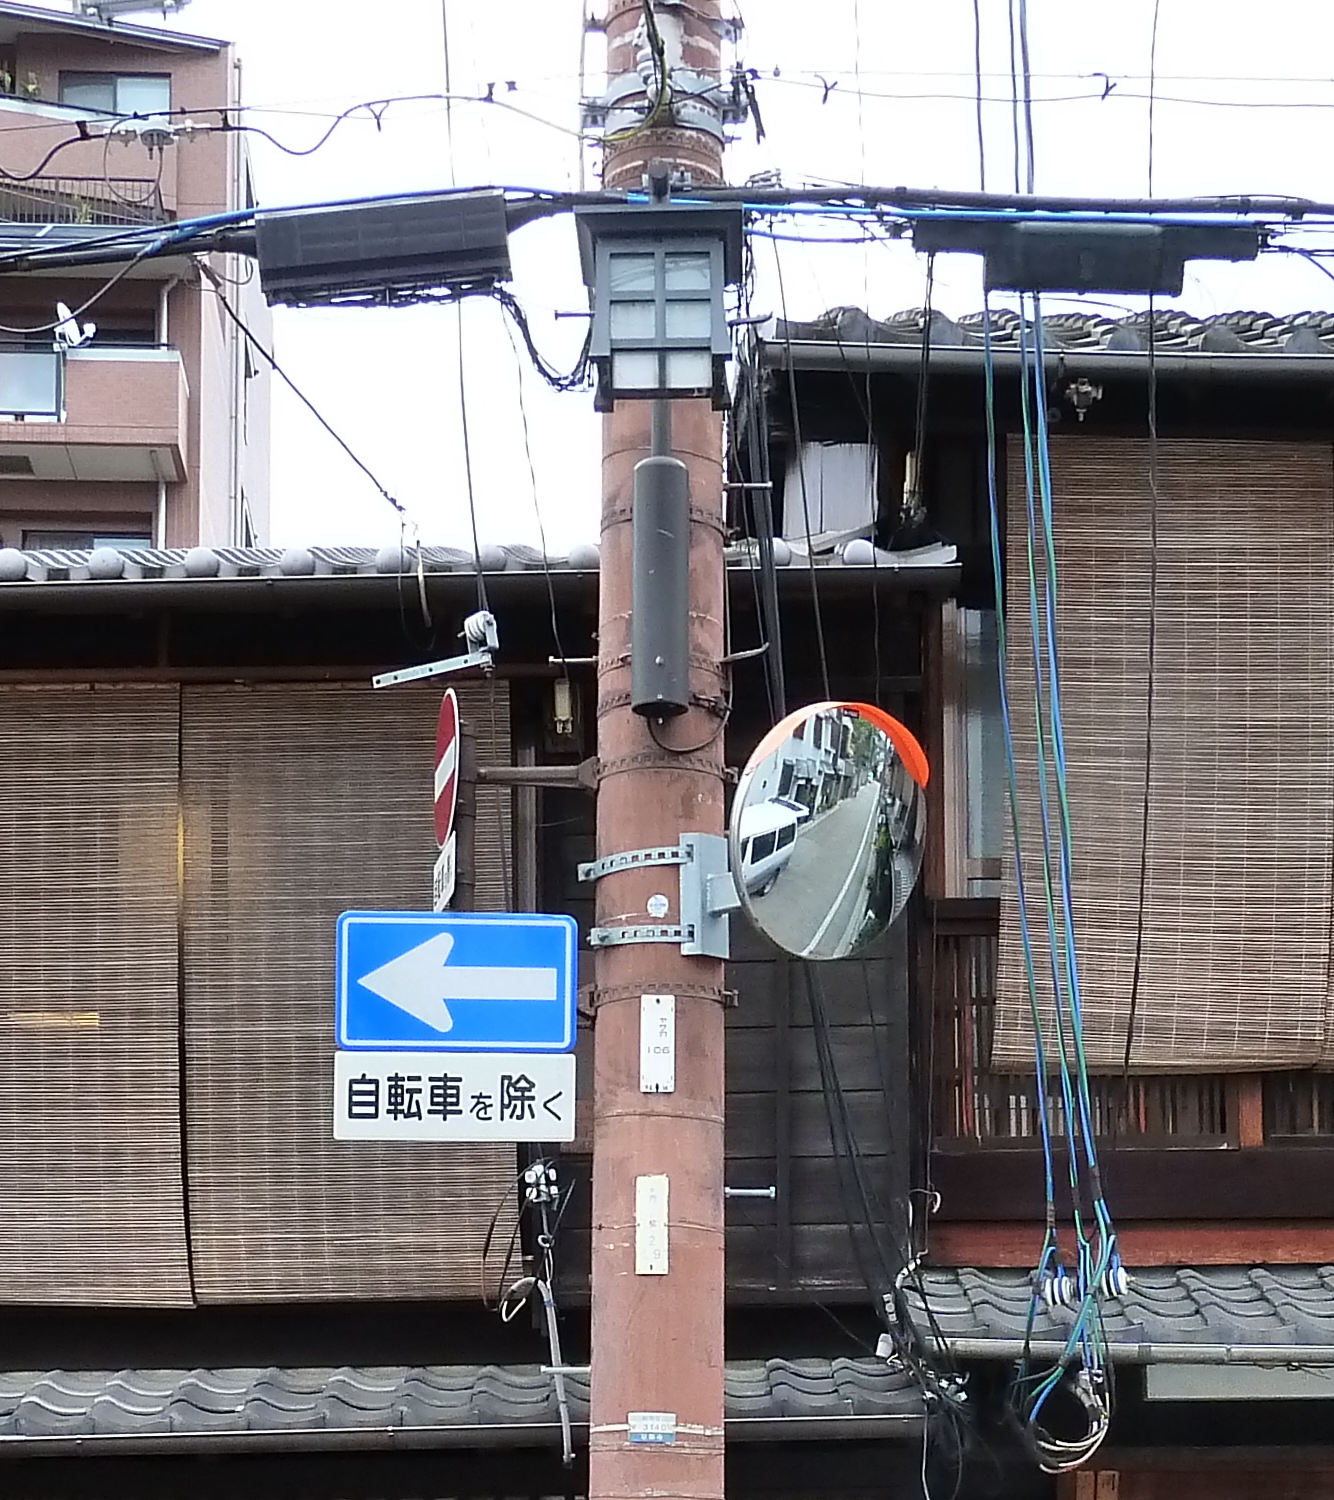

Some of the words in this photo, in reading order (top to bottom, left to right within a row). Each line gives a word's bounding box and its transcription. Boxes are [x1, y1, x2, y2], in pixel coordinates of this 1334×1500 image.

[348, 1072, 563, 1122] 自転車を除く
